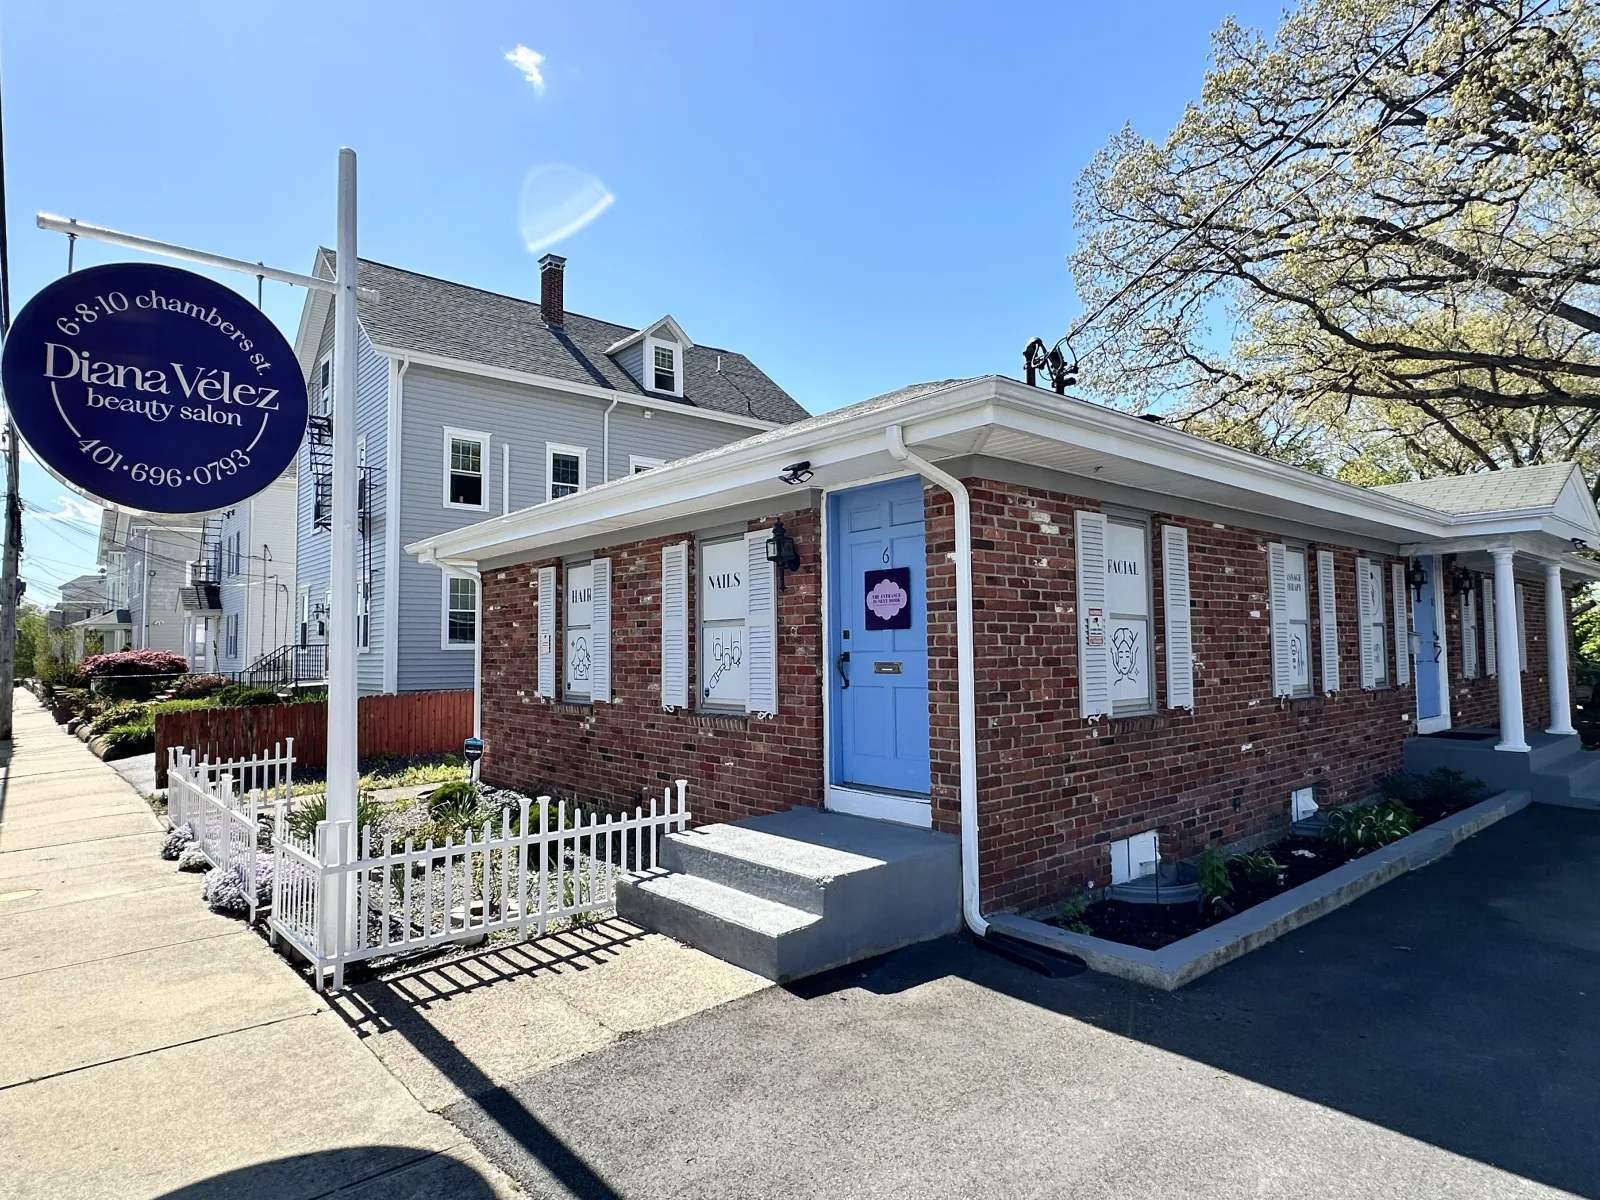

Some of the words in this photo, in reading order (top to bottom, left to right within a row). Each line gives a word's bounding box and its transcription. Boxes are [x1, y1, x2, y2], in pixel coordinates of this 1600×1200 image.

[135, 289, 253, 352] chambers
[249, 351, 271, 377] st.
[43, 341, 170, 395] Diana
[170, 362, 279, 411] Vélez
[86, 387, 174, 422] beauty
[180, 404, 243, 427] salon
[882, 546, 890, 564] 6
[1108, 559, 1138, 576] FACIAL
[708, 572, 741, 590] NAILS
[1286, 574, 1302, 582] SSAGE
[572, 588, 591, 603] HAIR
